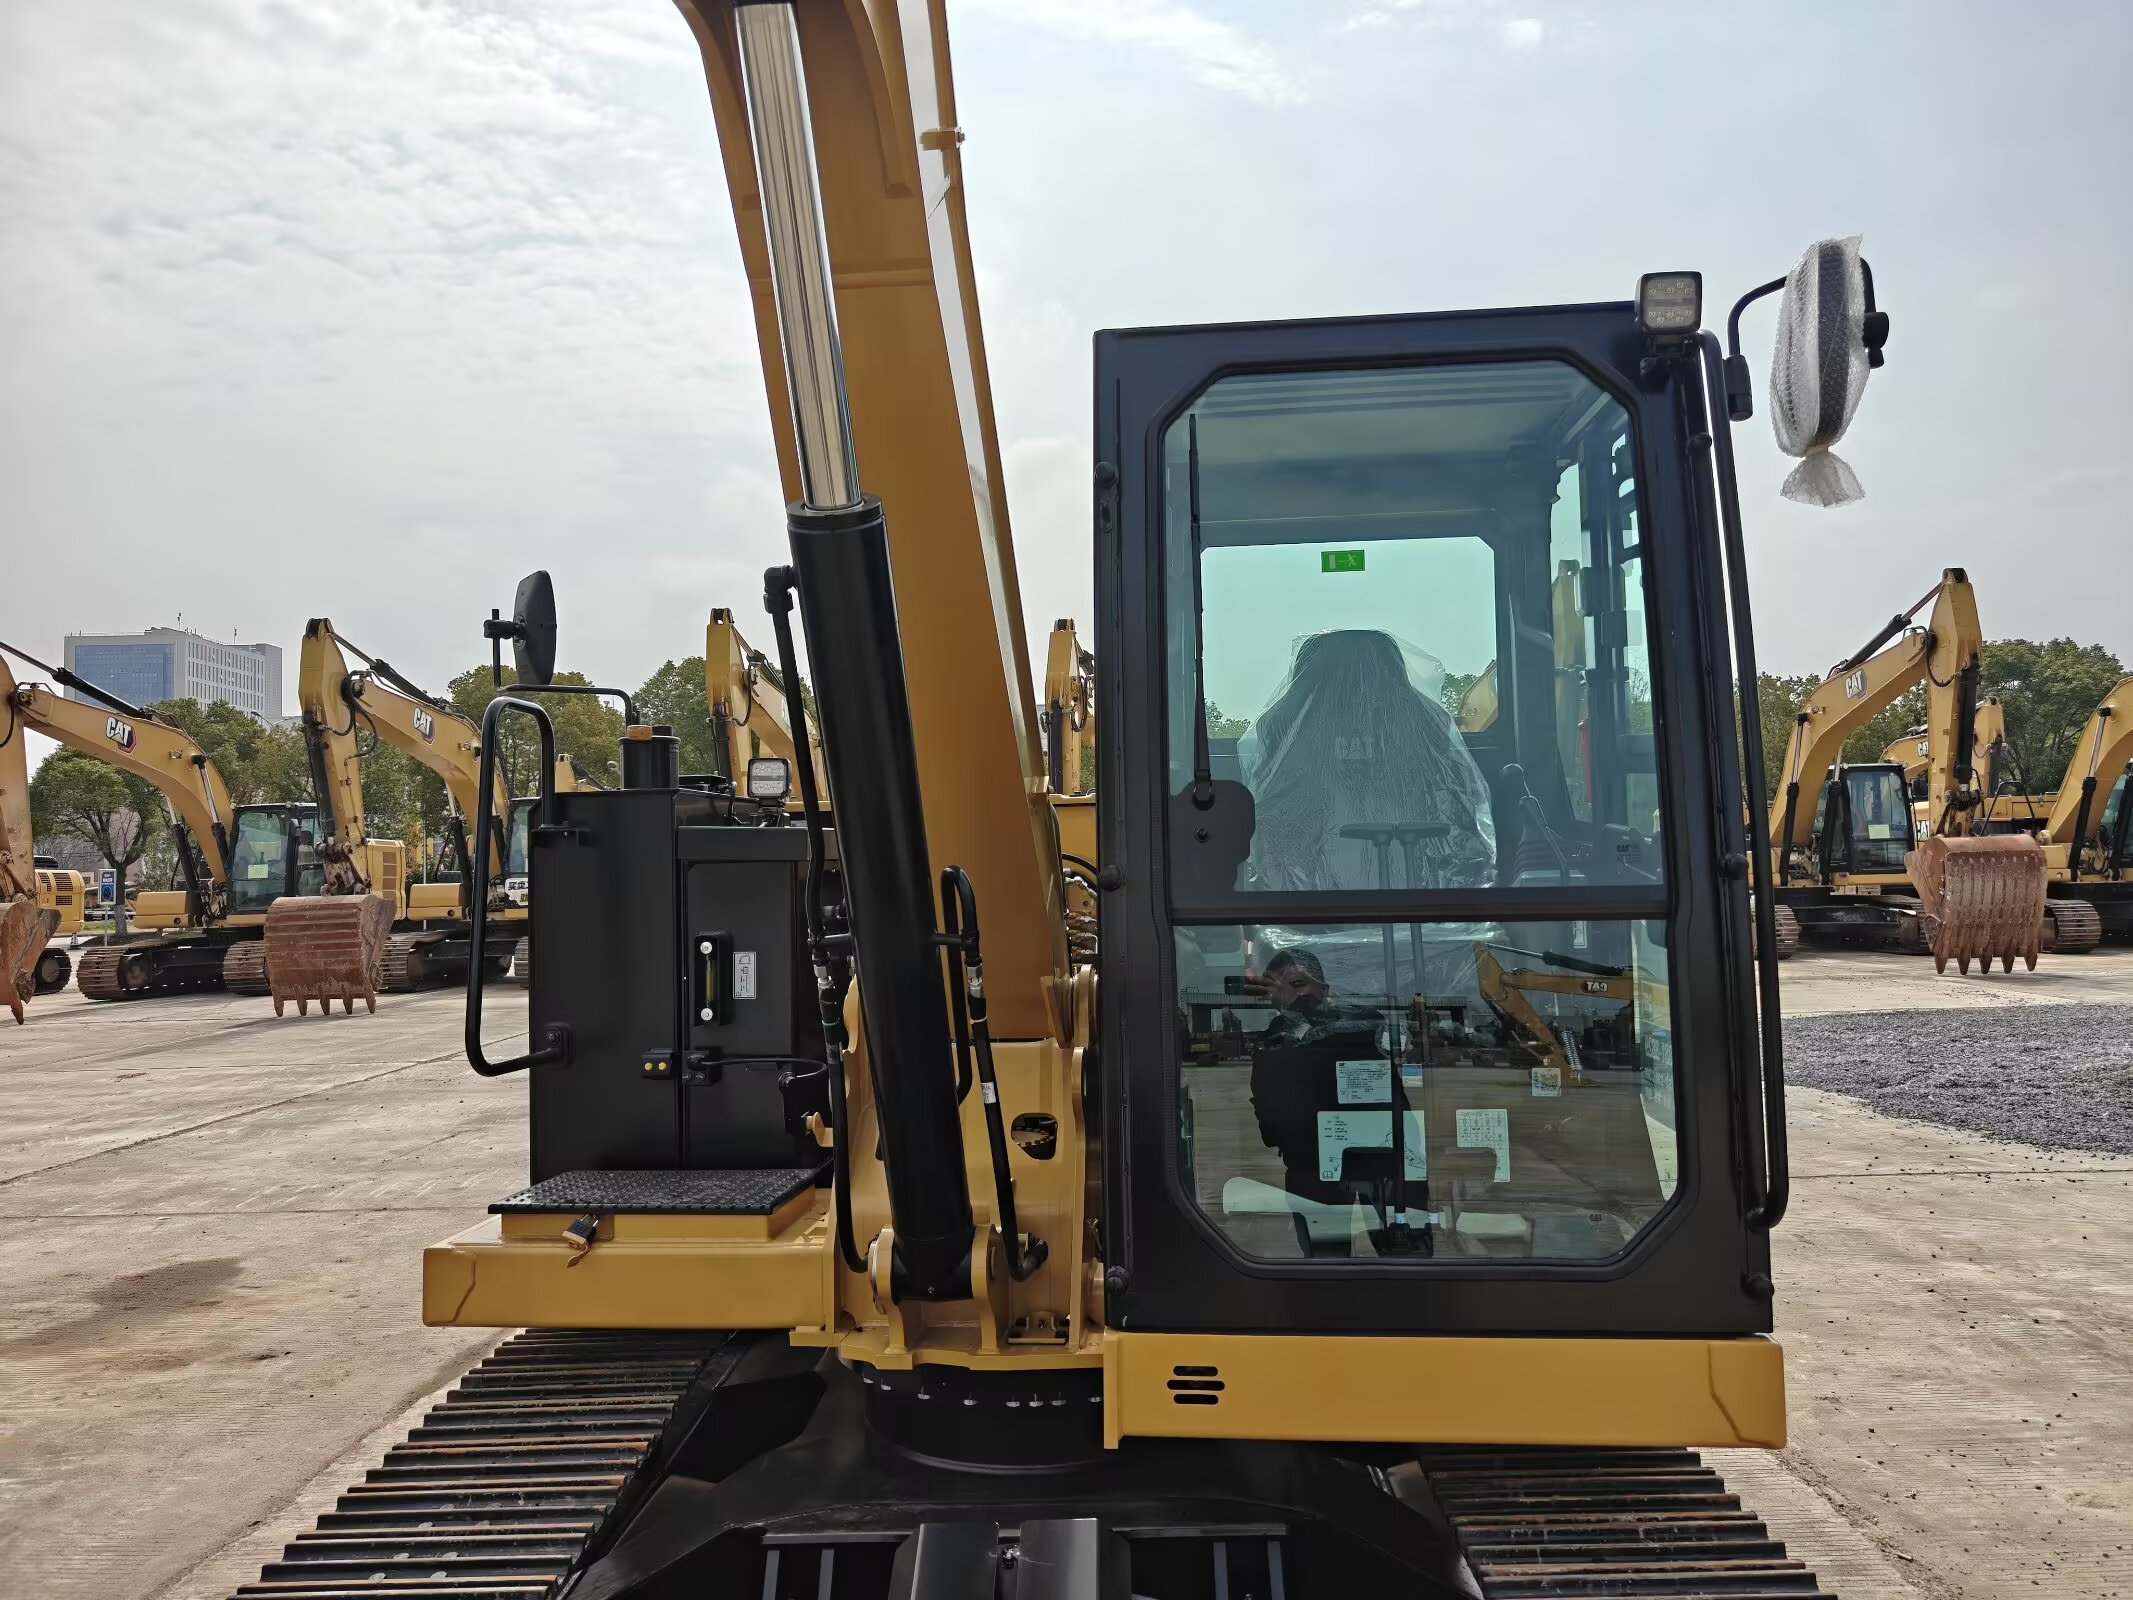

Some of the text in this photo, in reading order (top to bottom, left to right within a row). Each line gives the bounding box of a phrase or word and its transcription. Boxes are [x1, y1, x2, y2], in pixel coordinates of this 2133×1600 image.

[1845, 670, 1862, 699] CAT
[106, 716, 132, 746] CAT
[413, 706, 432, 737] CAT
